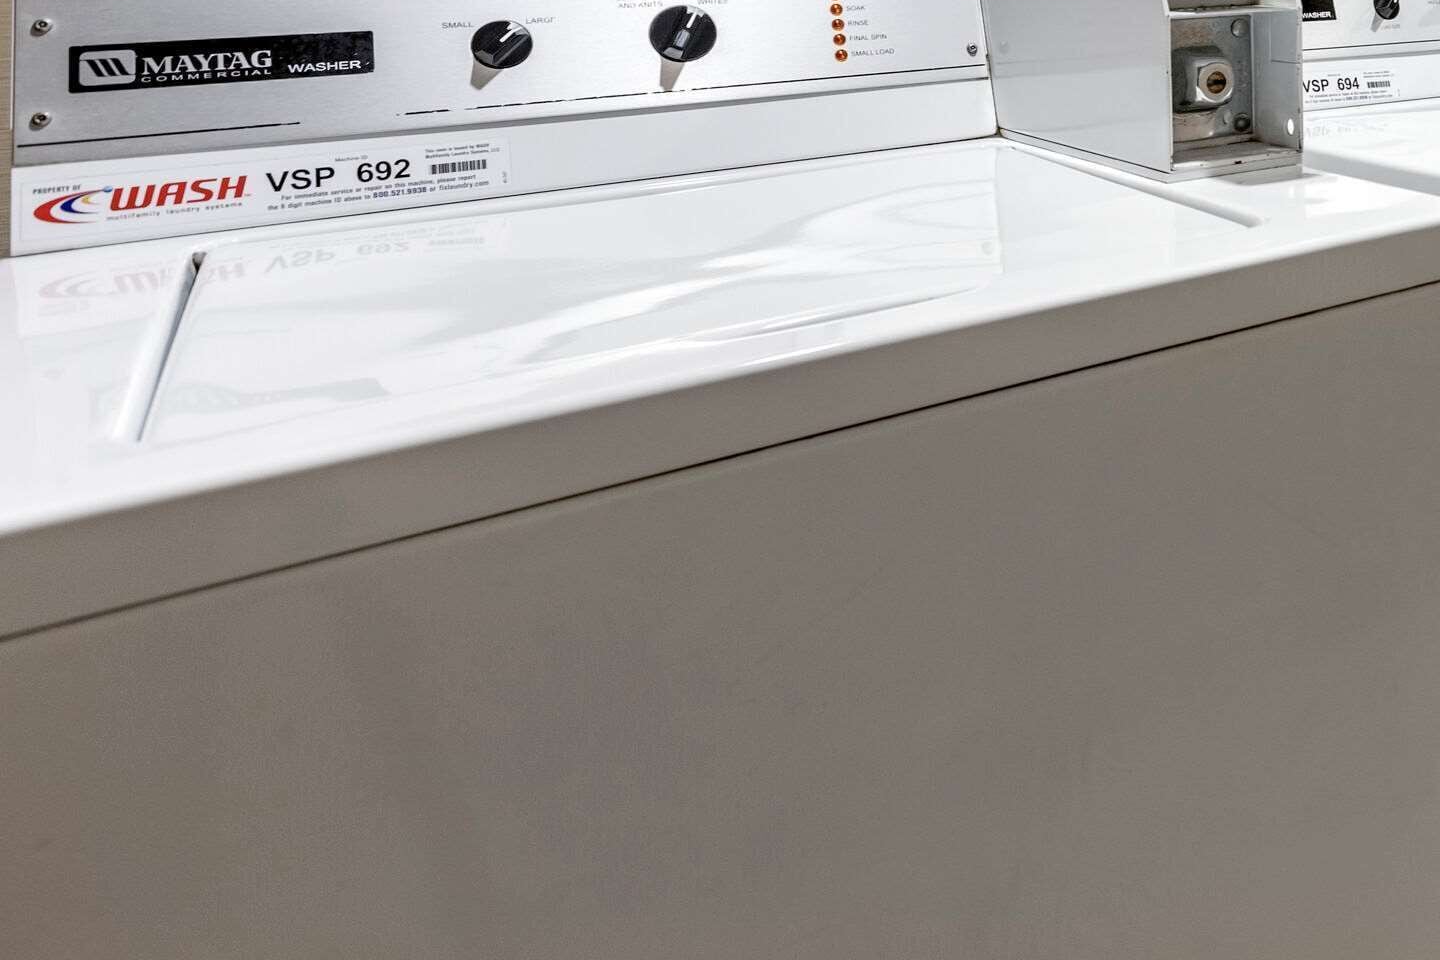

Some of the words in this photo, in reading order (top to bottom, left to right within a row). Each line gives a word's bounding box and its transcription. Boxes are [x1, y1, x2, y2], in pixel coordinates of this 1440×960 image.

[1302, 11, 1332, 19] WASHER
[441, 21, 475, 30] SMALL
[847, 19, 869, 27] RINSE
[870, 33, 888, 41] SPIN
[851, 49, 875, 57] SMALL
[875, 47, 895, 56] LOAD
[141, 49, 273, 76] MAYTAG
[287, 59, 362, 74] WASHER
[141, 68, 272, 84] COMMERCIAL
[1302, 78, 1330, 93] VSP
[1336, 76, 1360, 91] 694
[265, 166, 335, 193] VSP
[356, 158, 411, 183] 692
[32, 185, 70, 195] PROPERTY
[72, 183, 82, 191] OF
[109, 174, 249, 212] WASH
[294, 191, 329, 200] immediate
[330, 188, 353, 196] service
[364, 184, 383, 192] repair
[437, 176, 456, 185] please
[458, 174, 477, 182] report
[106, 211, 161, 221] multifamily
[166, 206, 200, 216] laundry
[205, 201, 243, 211] systems
